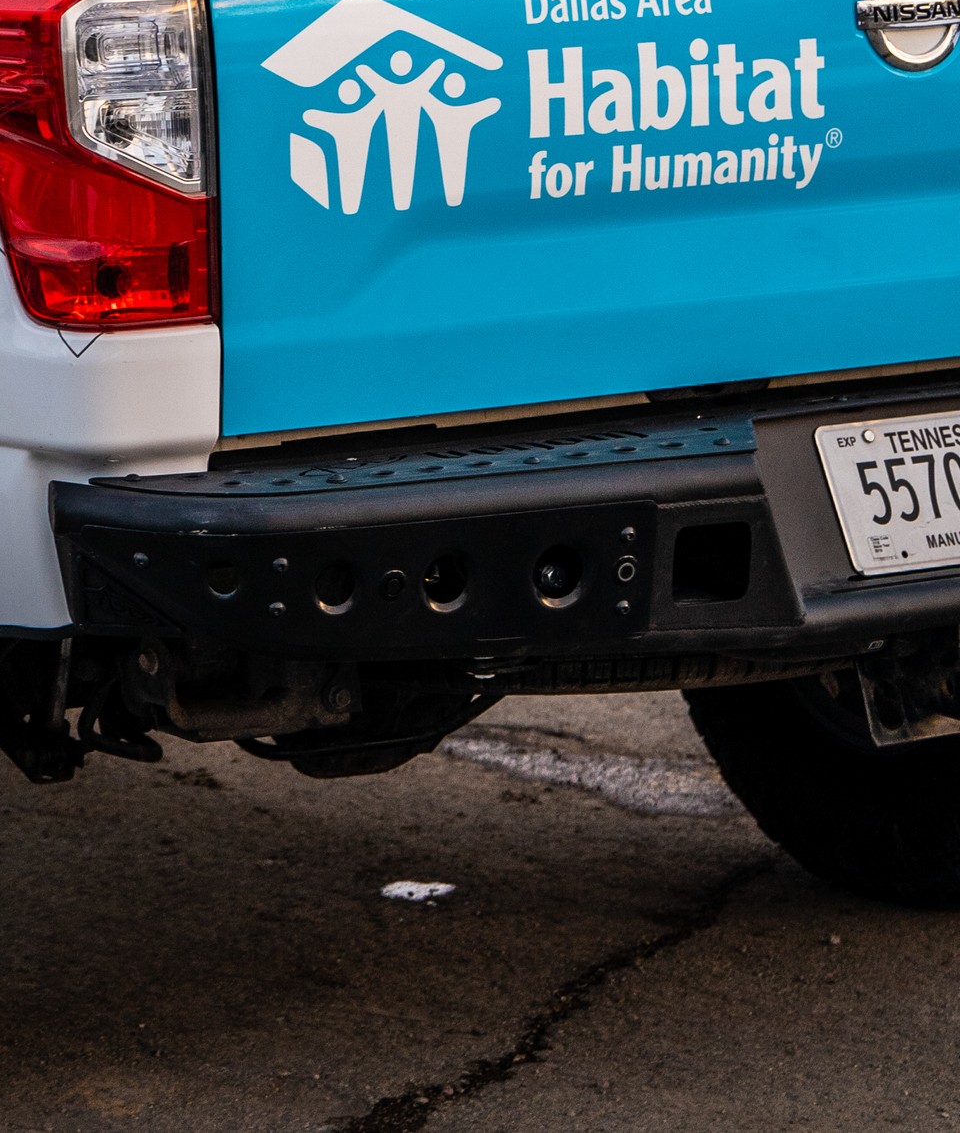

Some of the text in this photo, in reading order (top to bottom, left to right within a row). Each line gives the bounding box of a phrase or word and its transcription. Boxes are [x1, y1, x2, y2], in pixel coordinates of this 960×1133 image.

[873, 0, 960, 23] NISSAN
[527, 38, 825, 139] Habitat
[529, 151, 594, 199] for
[837, 437, 857, 448] EXP
